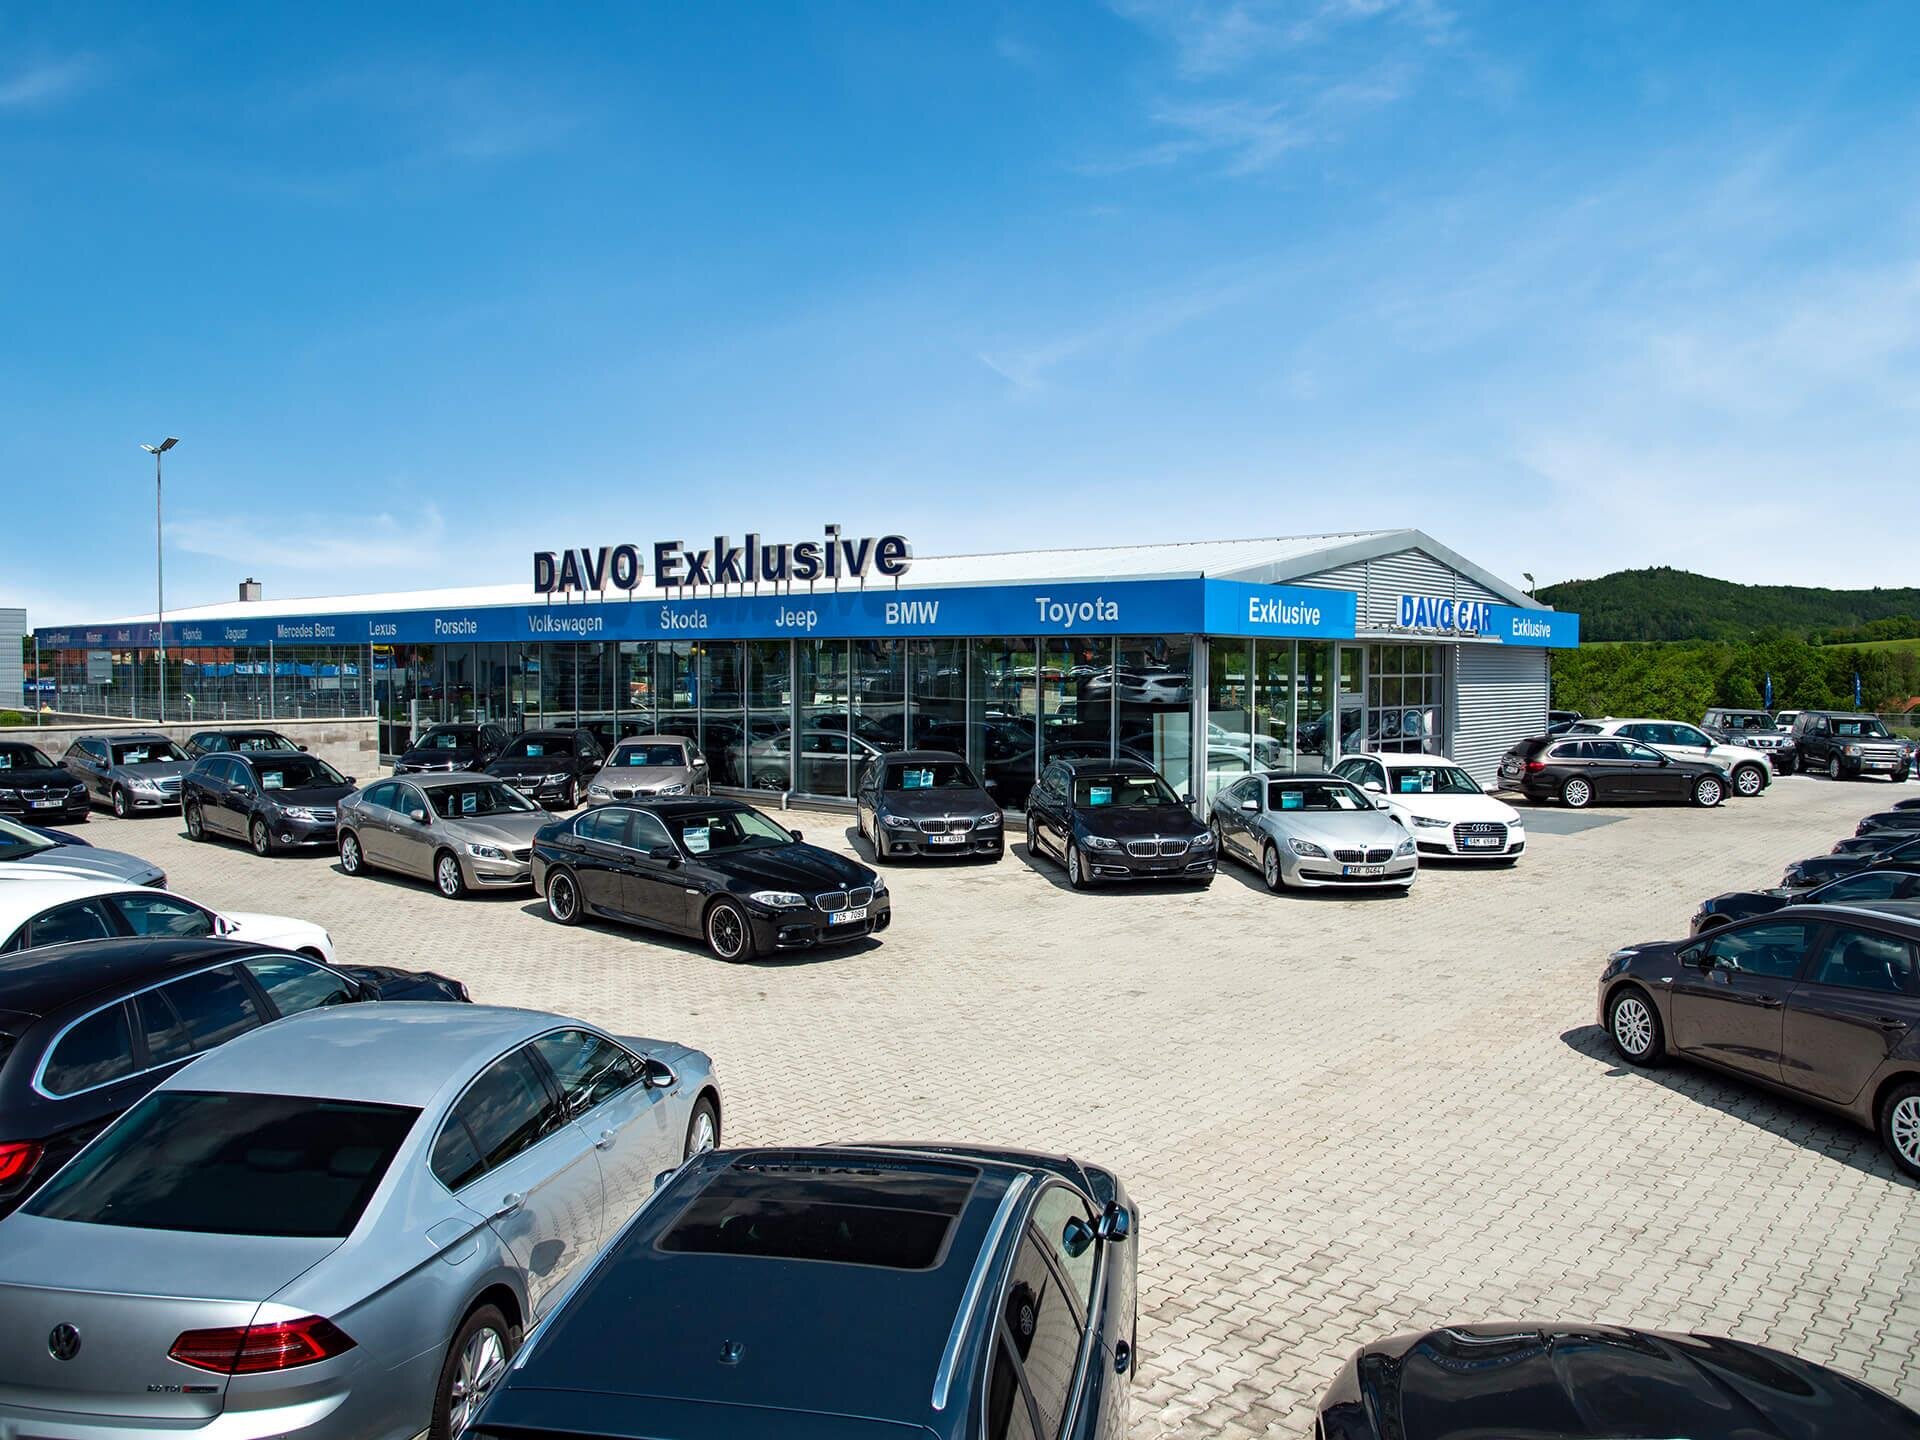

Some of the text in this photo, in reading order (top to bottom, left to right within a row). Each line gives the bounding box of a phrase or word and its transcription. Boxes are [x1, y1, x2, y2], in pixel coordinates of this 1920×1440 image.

[534, 523, 913, 594] DAVO Exklusive
[660, 605, 708, 630] Škoda
[775, 606, 818, 632] Jeep
[885, 600, 940, 625] BMW
[1036, 595, 1120, 628] Toyota
[1248, 597, 1321, 627] Exklusive
[182, 627, 202, 641] Honda
[225, 626, 249, 642] Jaguar
[277, 622, 335, 639] Mercedes Benz
[369, 620, 397, 636] Lexus
[434, 617, 478, 635] Porsche
[528, 613, 604, 636] Volkswagen
[1512, 618, 1551, 638] Exklusive
